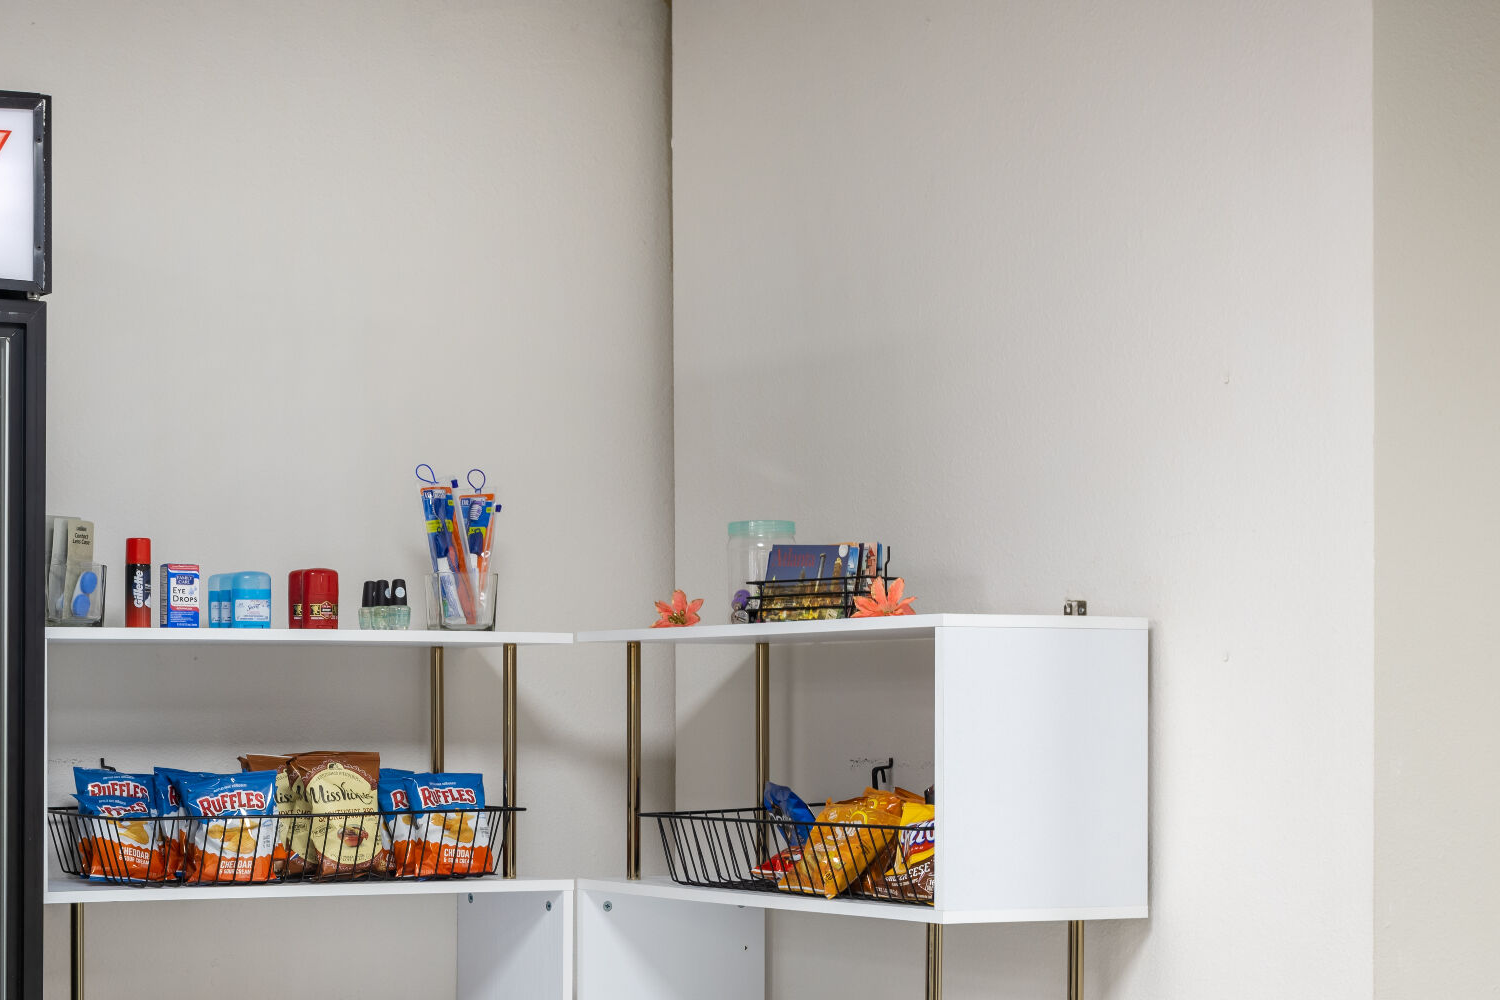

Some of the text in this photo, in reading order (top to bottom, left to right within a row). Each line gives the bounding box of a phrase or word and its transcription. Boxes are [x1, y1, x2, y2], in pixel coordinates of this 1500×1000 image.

[74, 532, 89, 540] Contact
[771, 547, 816, 568] Atlanta
[132, 569, 144, 609] Gillette
[172, 586, 186, 595] EYE
[172, 594, 198, 603] DROPS
[88, 781, 150, 800] RUFFLES
[309, 783, 341, 804] Miss
[419, 786, 477, 808] RUFFLES
[197, 789, 267, 817] RUFFLES
